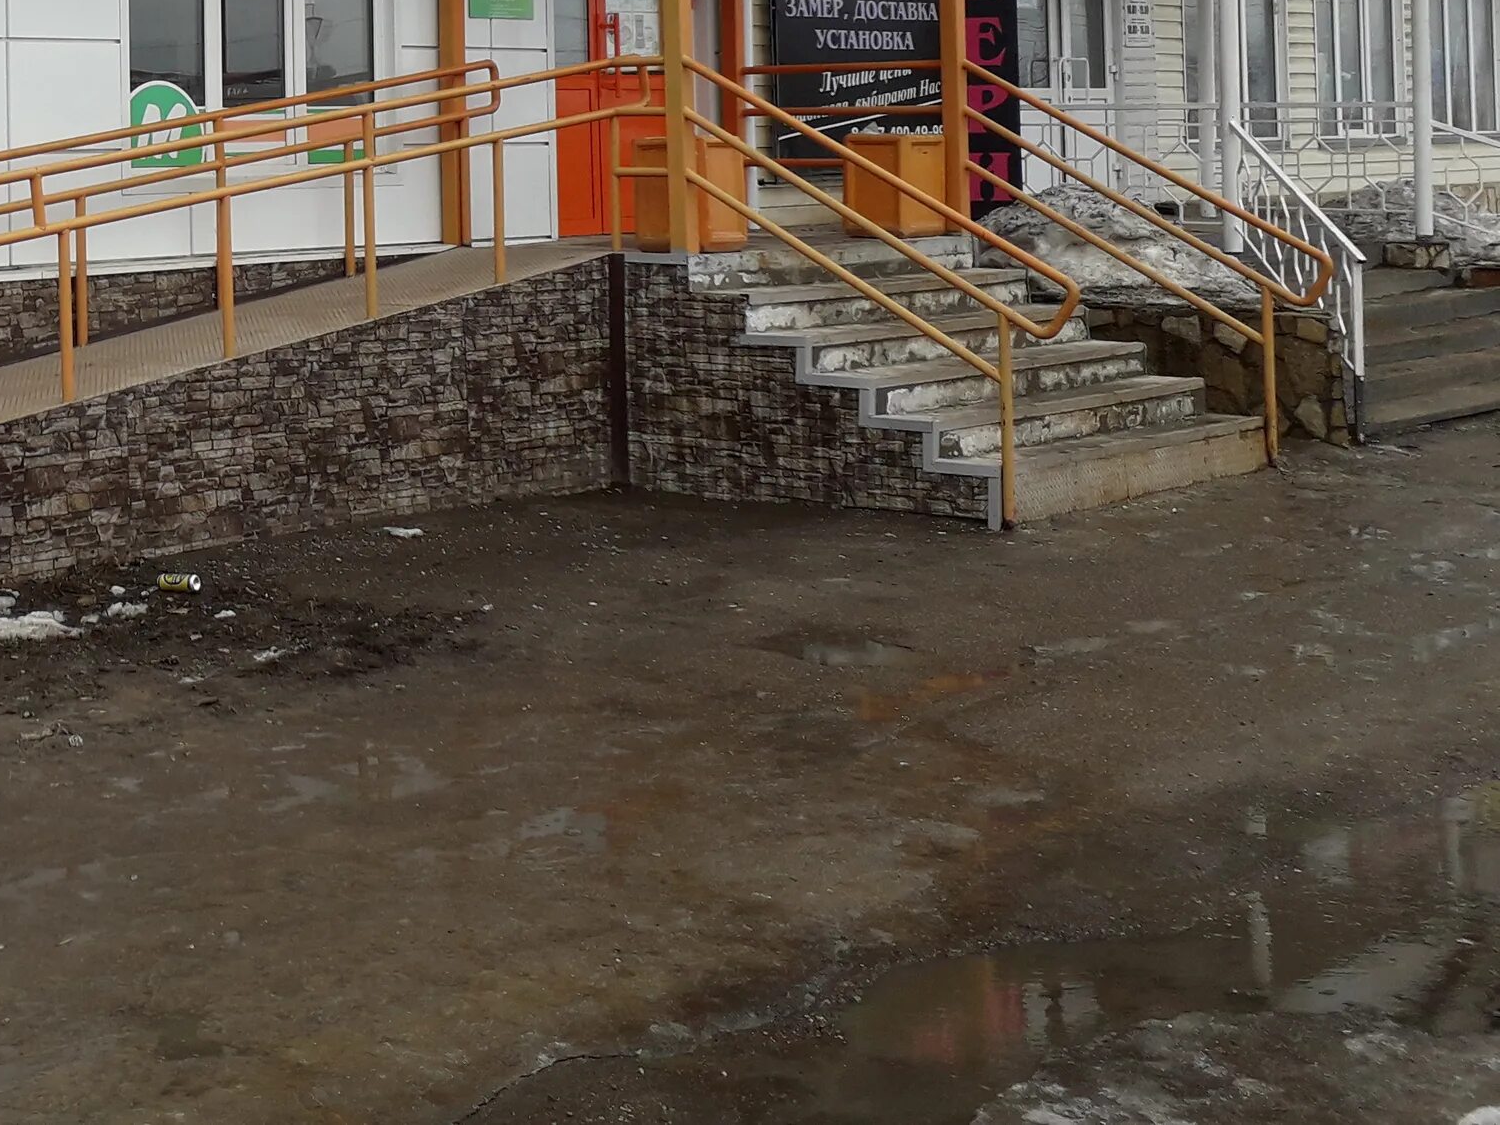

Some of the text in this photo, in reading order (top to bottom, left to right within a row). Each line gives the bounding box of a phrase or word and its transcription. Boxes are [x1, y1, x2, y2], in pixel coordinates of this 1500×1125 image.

[853, 0, 939, 24] ДОСТАВКА
[814, 28, 915, 51] УСТАНОВКА
[819, 68, 876, 97] Лучшие
[919, 77, 941, 97] Нас
